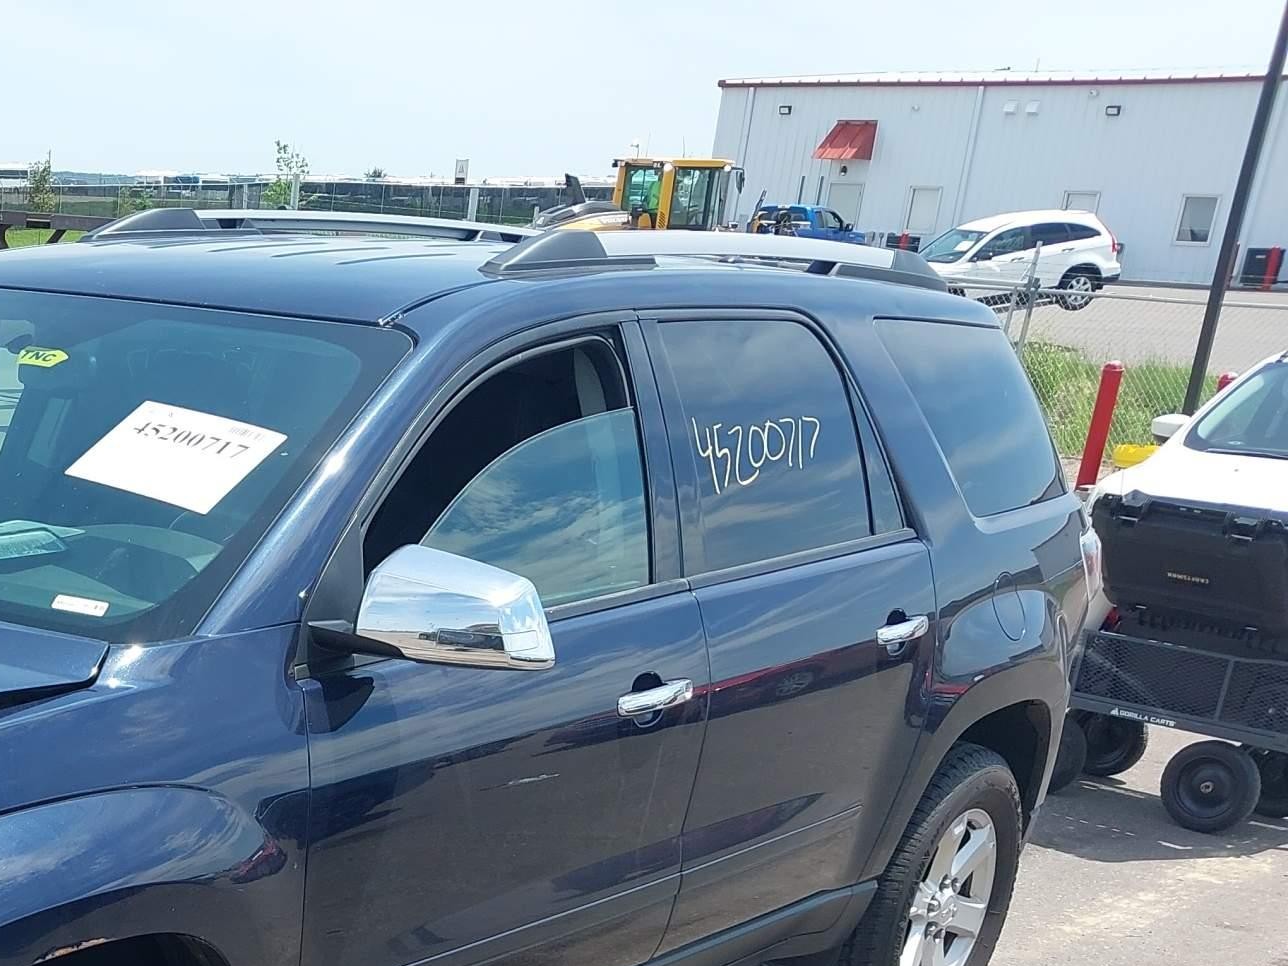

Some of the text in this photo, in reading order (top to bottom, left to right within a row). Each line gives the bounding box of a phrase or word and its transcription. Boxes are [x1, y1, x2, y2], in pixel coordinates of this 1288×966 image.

[20, 349, 57, 363] TNC
[133, 420, 250, 459] 45200717
[691, 415, 820, 495] 45200717
[1119, 709, 1148, 722] GORILLA
